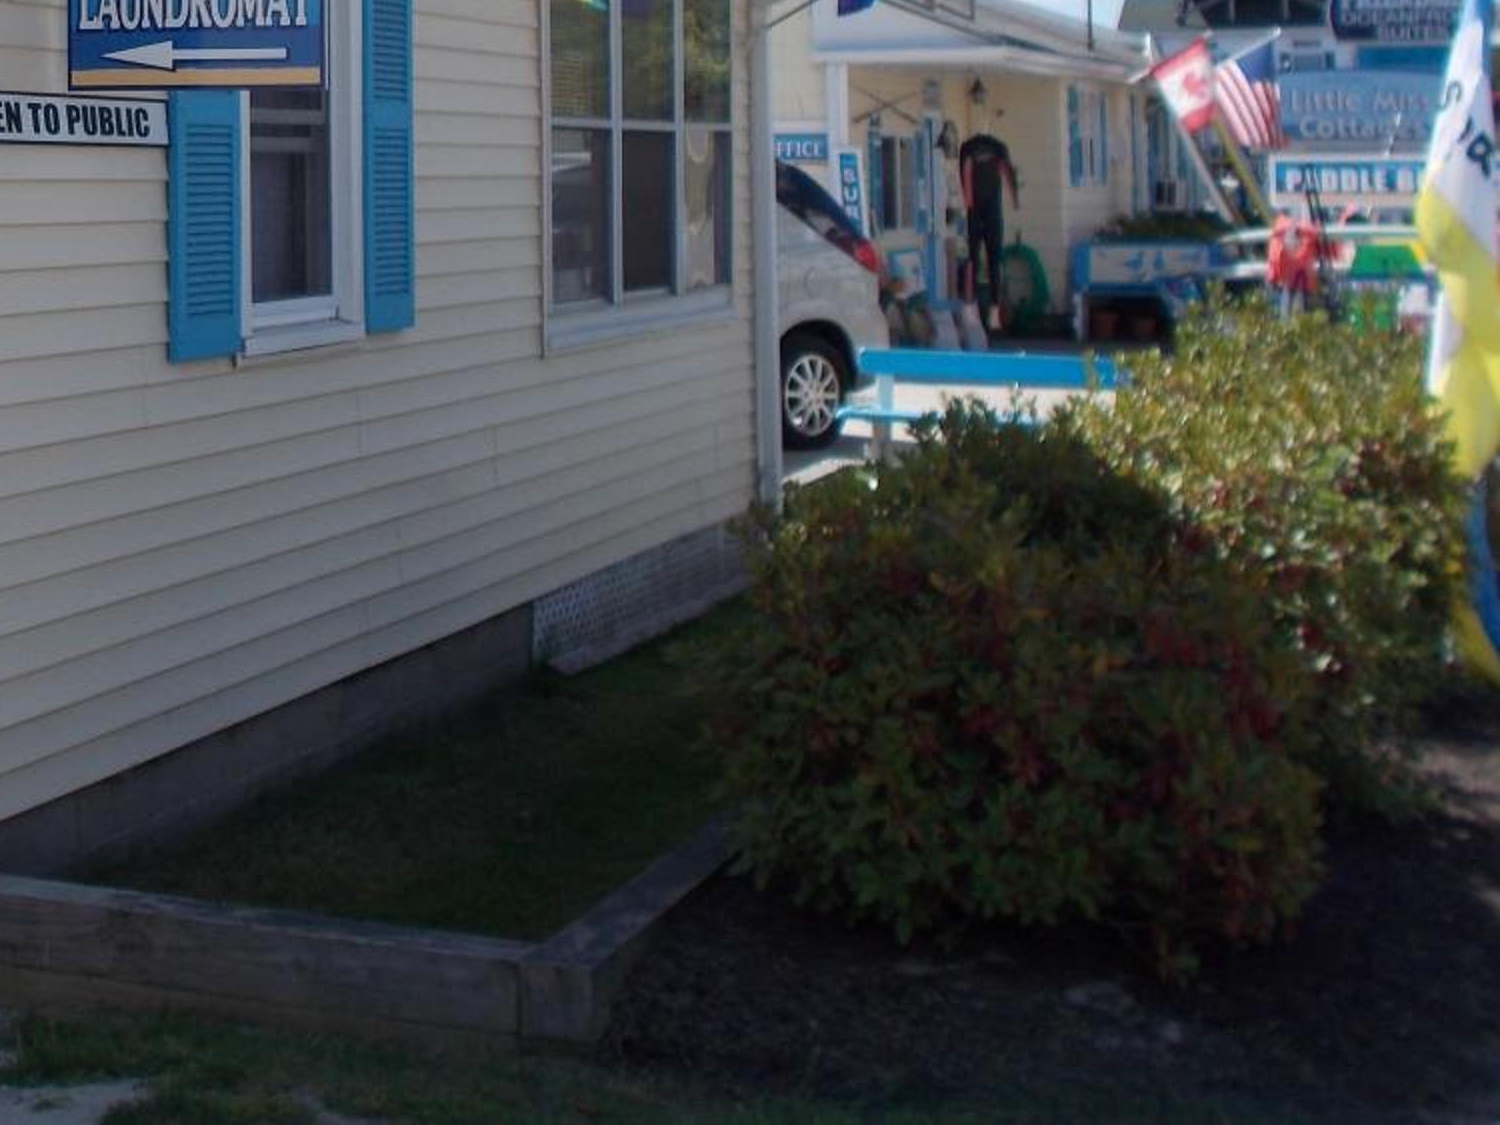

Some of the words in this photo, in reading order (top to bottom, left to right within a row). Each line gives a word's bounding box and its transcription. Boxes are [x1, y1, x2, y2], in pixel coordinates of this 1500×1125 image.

[28, 103, 60, 136] TO
[67, 105, 151, 138] PUBLIC
[772, 140, 822, 157] FFICE
[1284, 167, 1388, 192] PADDLE
